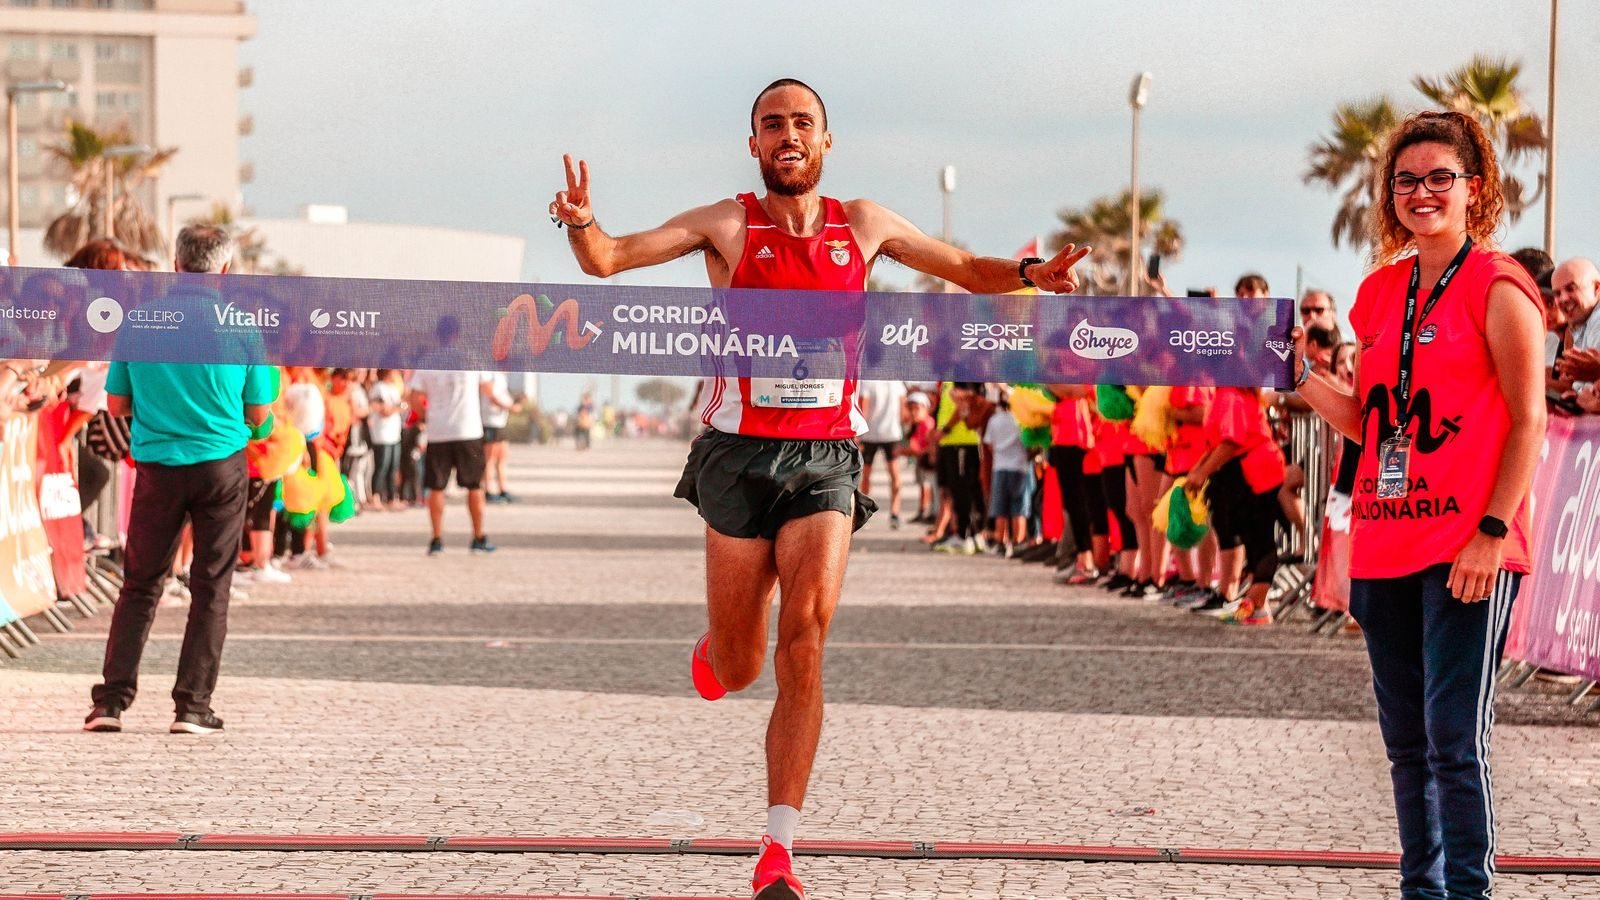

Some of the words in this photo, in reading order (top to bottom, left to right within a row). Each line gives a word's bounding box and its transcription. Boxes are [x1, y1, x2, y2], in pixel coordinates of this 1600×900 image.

[127, 309, 185, 323] CELEIRO
[213, 301, 280, 327] Vitalis
[335, 310, 381, 328] SNT
[612, 304, 727, 325] CORRIDA
[880, 318, 929, 353] edp
[961, 323, 1034, 337] SPORT
[612, 327, 799, 358] MILIONÁRIA
[960, 338, 1033, 351] ZONE
[1073, 328, 1133, 357] Shoyce
[1169, 330, 1234, 353] ageas
[1196, 348, 1233, 357] seguros
[791, 359, 809, 381] 6
